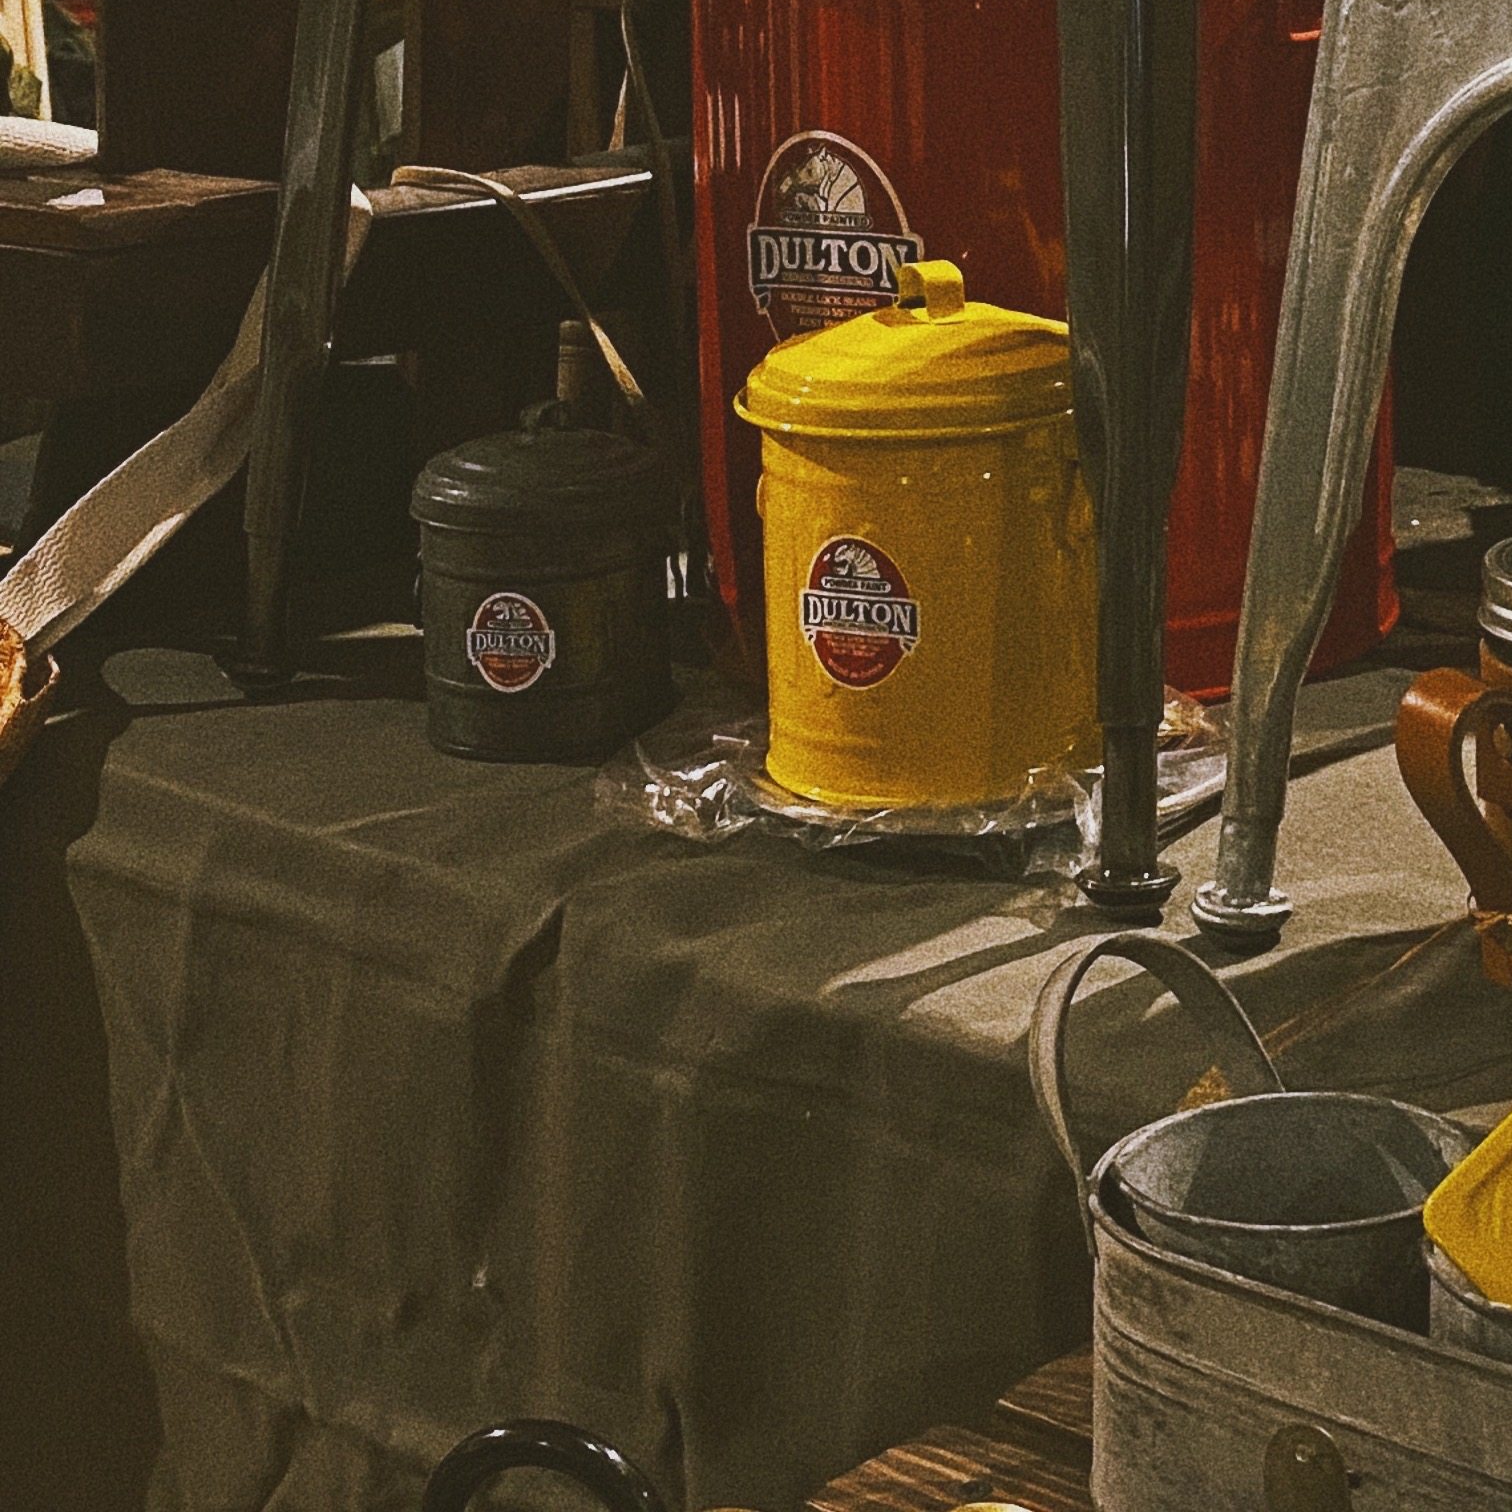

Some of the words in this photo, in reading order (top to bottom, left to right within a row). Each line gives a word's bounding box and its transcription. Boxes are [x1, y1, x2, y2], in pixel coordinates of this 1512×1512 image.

[758, 235, 909, 289] DULTON
[808, 596, 912, 633] DULTON
[476, 633, 546, 652] DULTON
